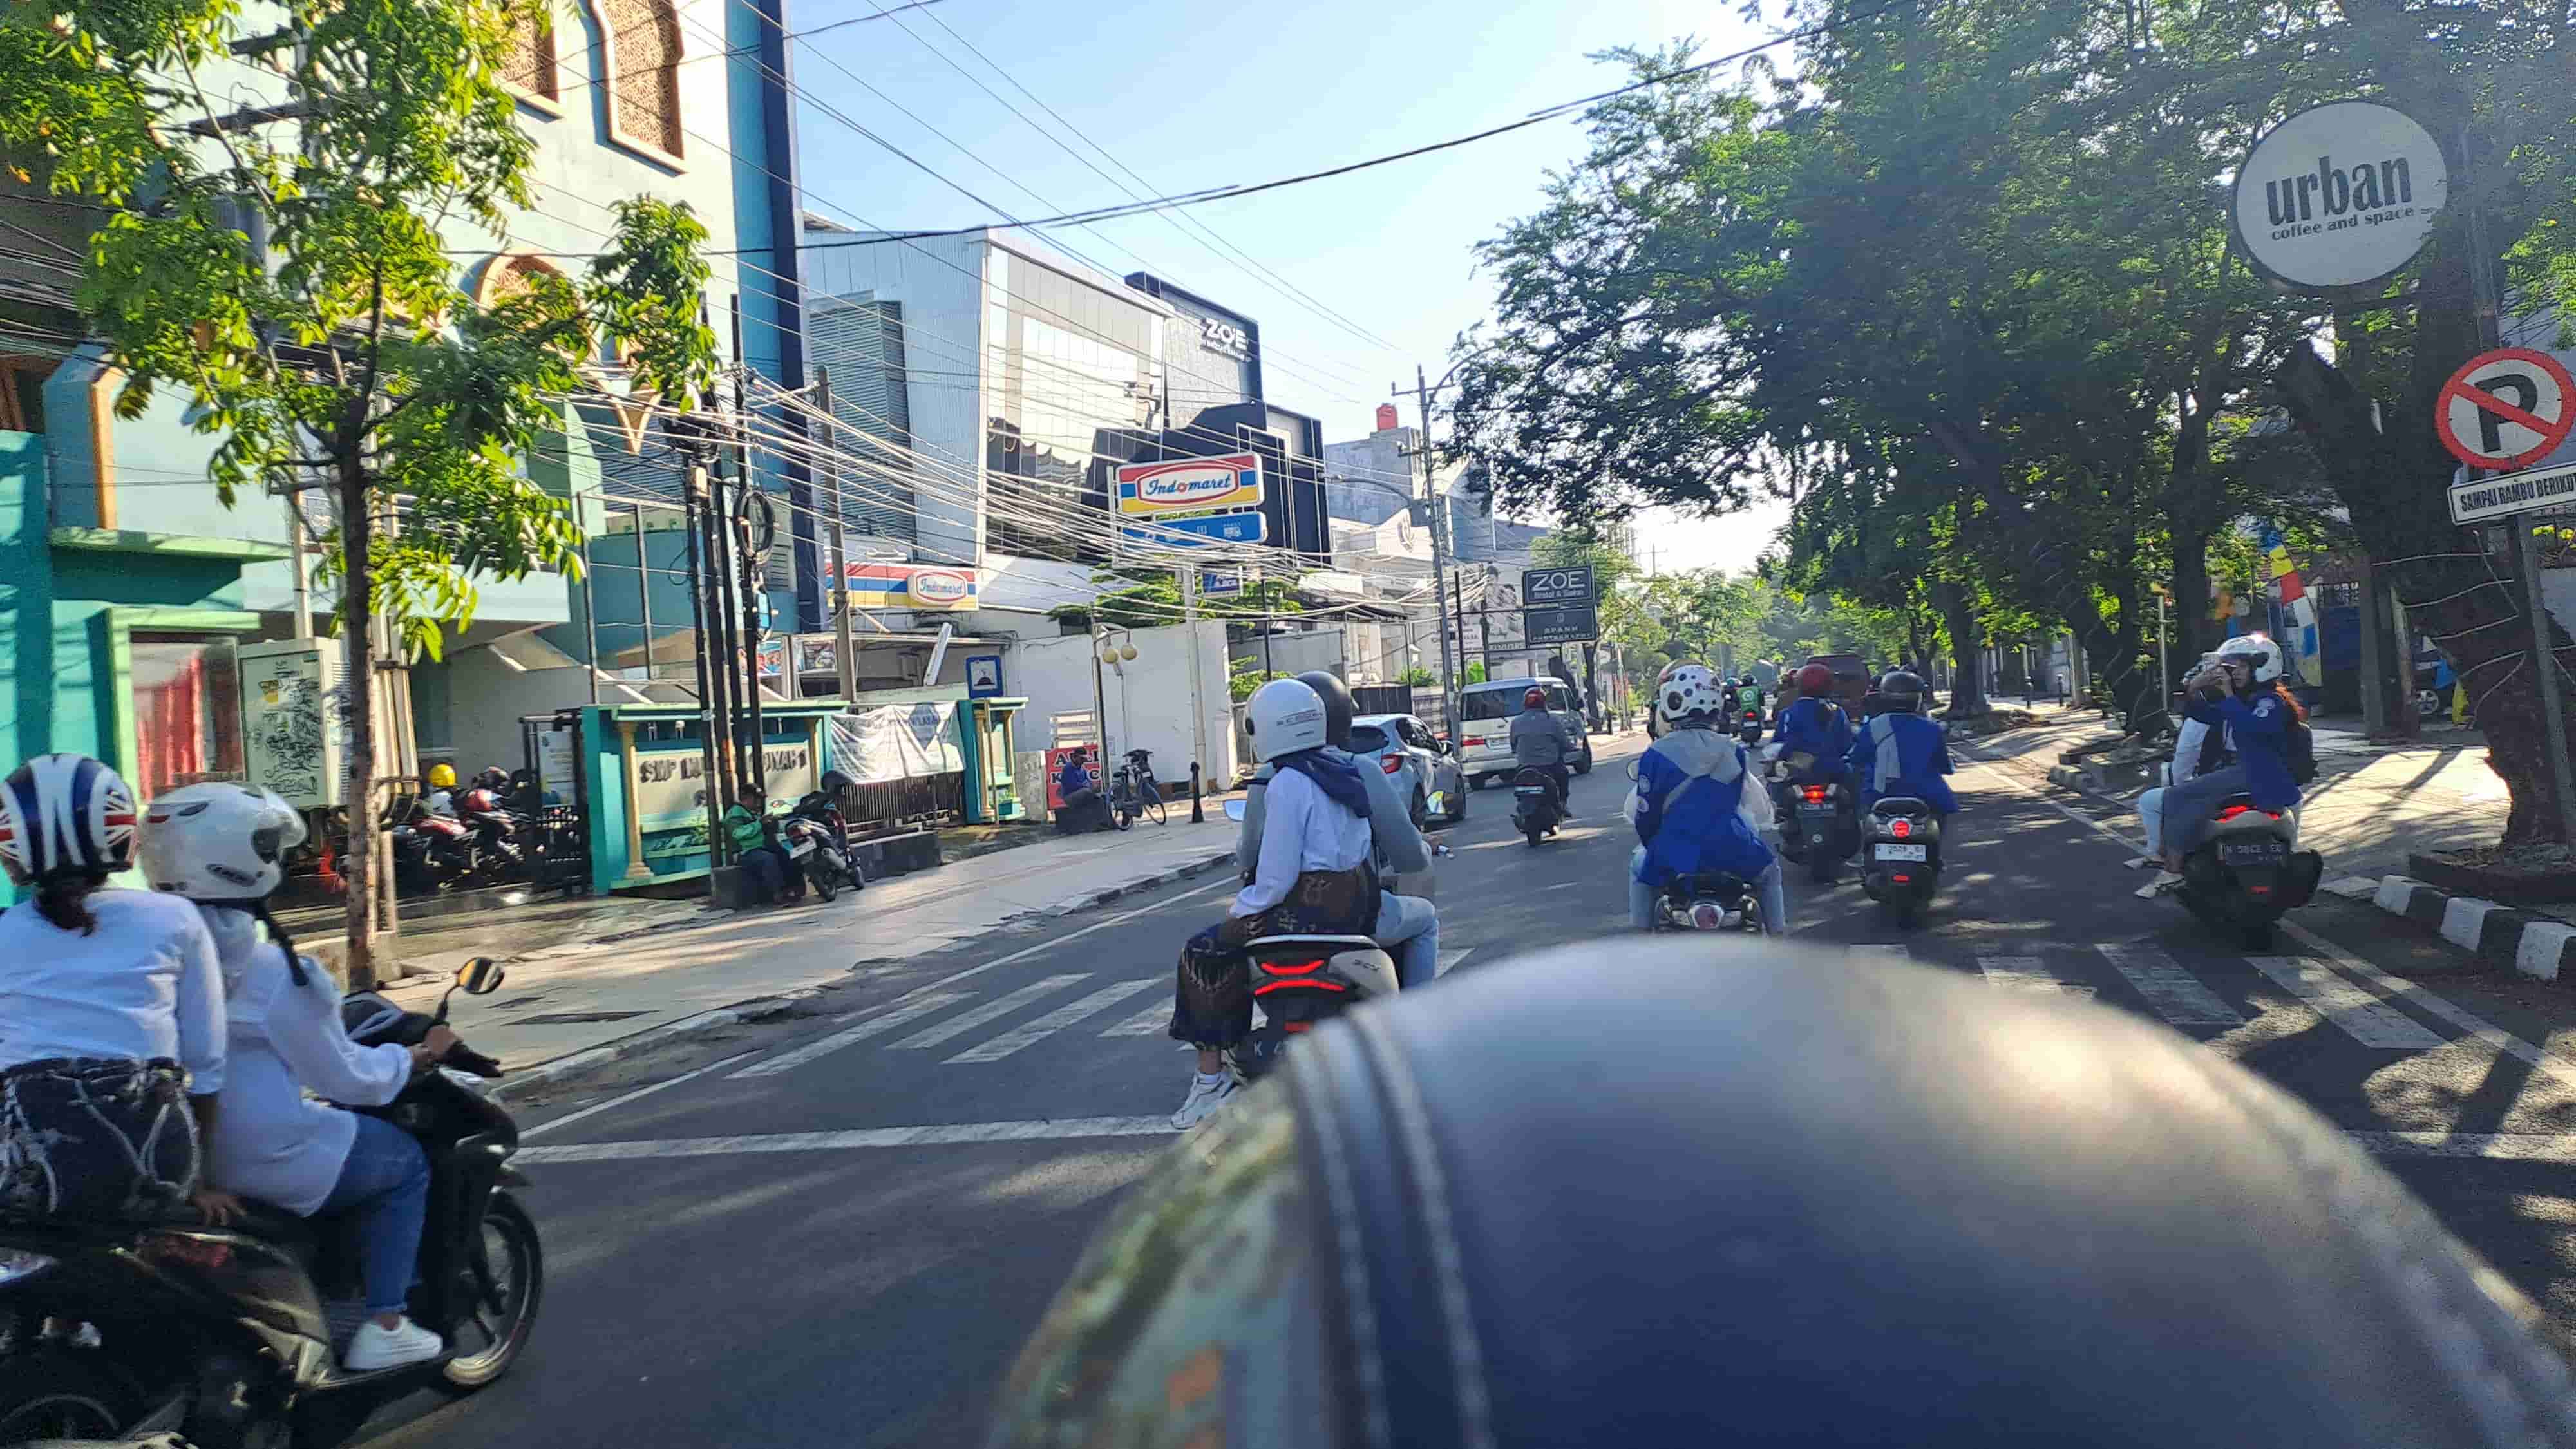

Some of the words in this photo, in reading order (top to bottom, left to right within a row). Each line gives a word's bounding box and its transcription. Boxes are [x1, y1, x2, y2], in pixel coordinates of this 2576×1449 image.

[2266, 156, 2412, 225] urban
[2271, 223, 2323, 241] coffee
[2327, 214, 2358, 231] and
[2364, 207, 2414, 225] space
[1206, 317, 1247, 350] ZOE
[1145, 473, 1231, 496] Indomaret
[2459, 488, 2499, 512] SAMPAI
[2497, 480, 2536, 505] RAMBU
[1531, 570, 1586, 592] ZOE
